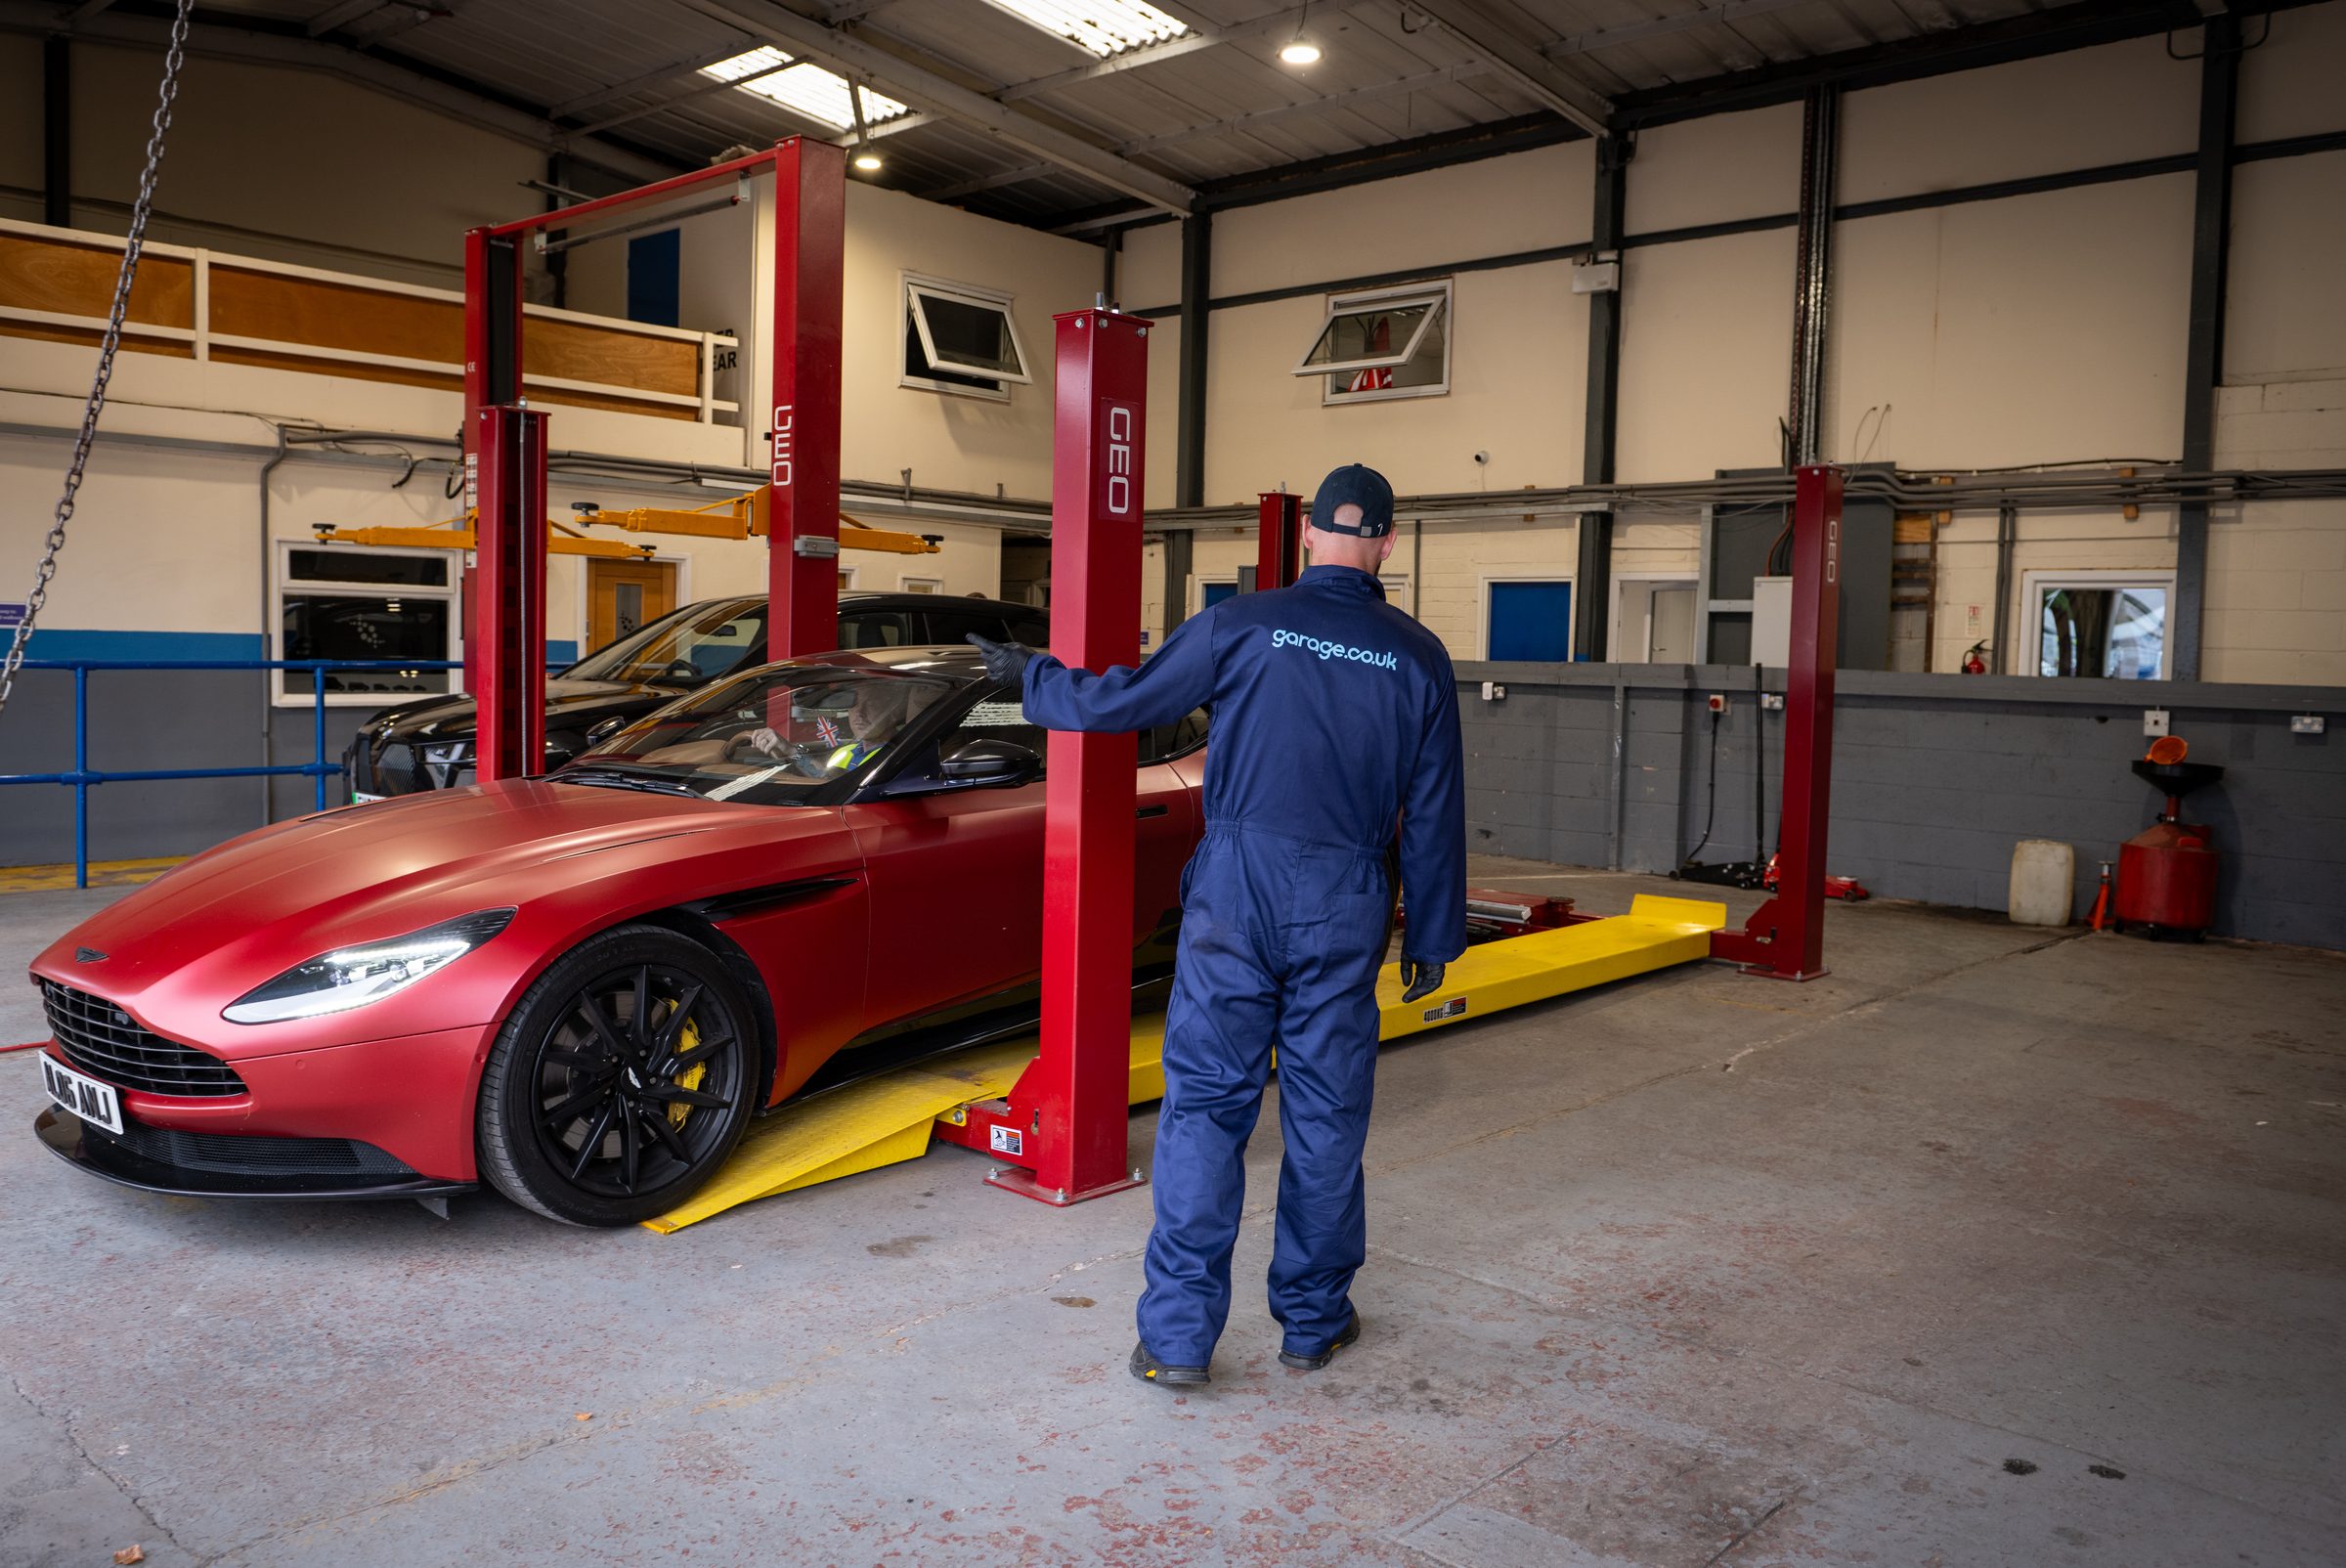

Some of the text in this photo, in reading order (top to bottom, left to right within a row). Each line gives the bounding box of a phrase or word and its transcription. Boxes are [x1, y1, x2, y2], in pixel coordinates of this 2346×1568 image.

[773, 405, 792, 487] GEO
[1108, 407, 1131, 514] GEO
[1827, 520, 1838, 583] GEO
[1272, 629, 1398, 671] garage.co.uk
